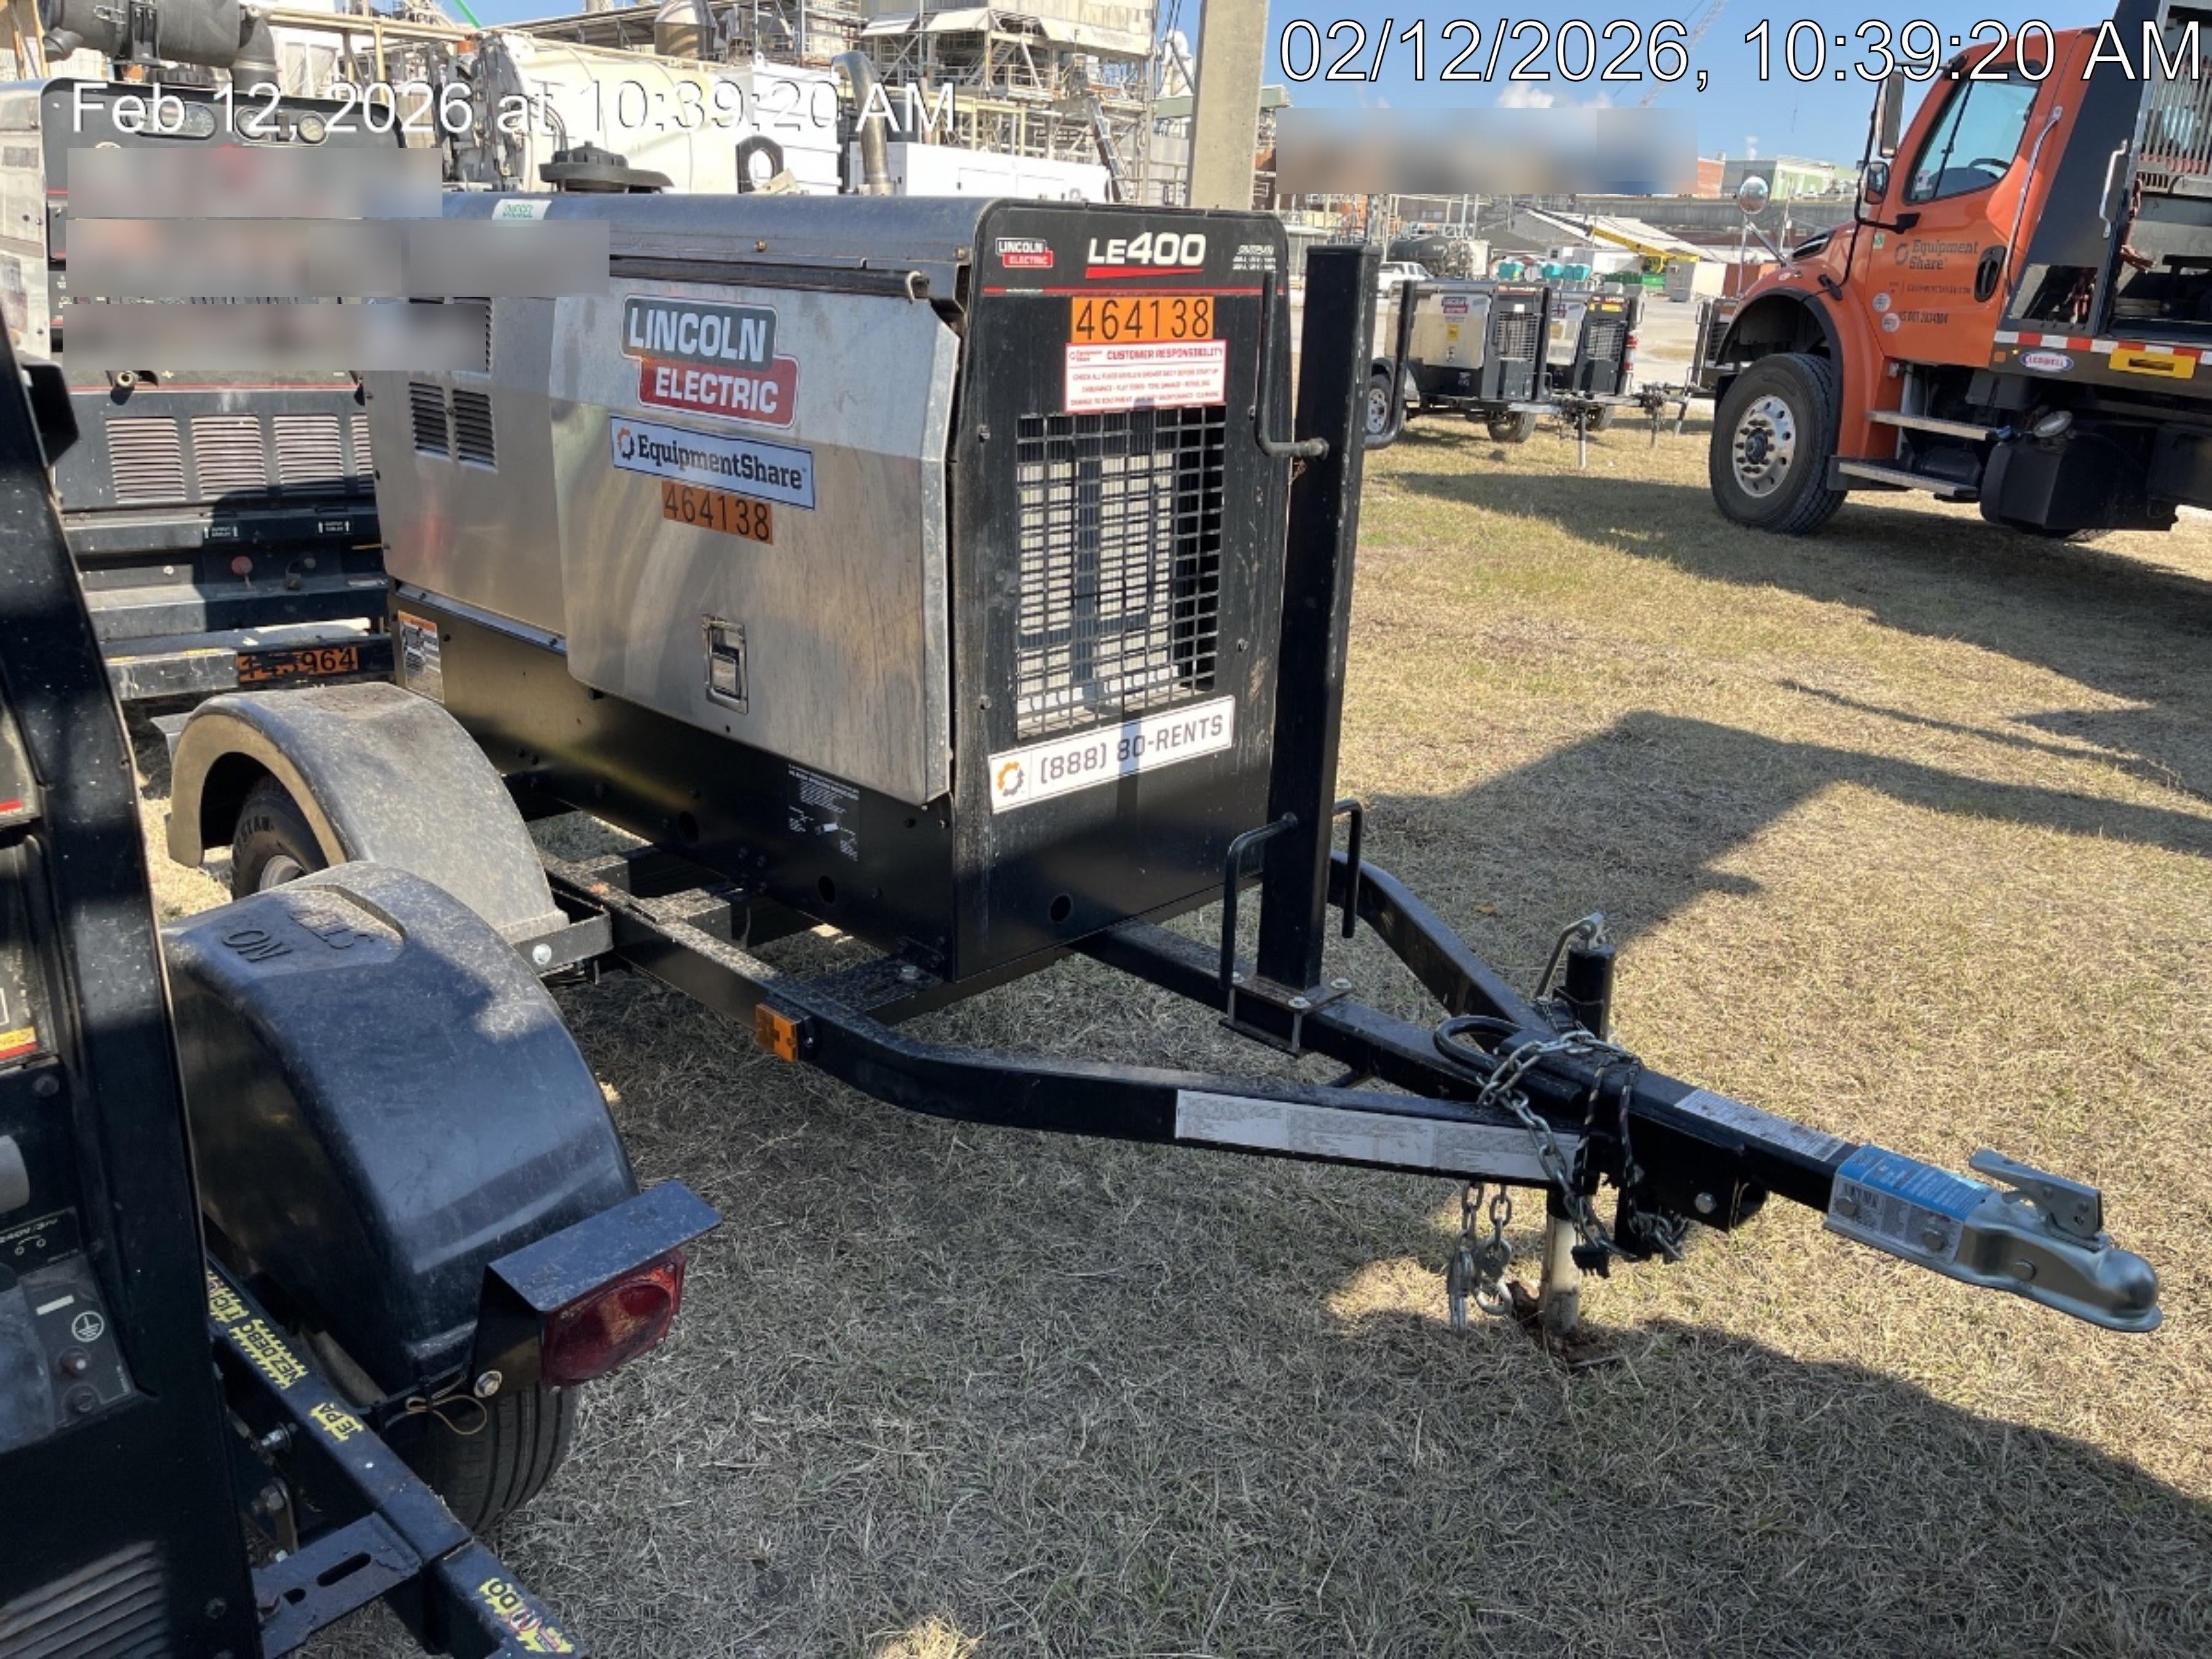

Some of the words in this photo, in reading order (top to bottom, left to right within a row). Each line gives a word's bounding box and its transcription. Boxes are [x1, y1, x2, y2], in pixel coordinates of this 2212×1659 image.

[998, 241, 1044, 253] LINCOLN
[1010, 256, 1048, 265] ELECTRIC
[1087, 231, 1207, 265] LE400
[1909, 256, 1944, 270] Share
[1912, 239, 1979, 256] Equipment
[629, 307, 767, 363] LINCOLN
[1076, 298, 1209, 340] 464138
[1107, 350, 1154, 360] CUSTOMER
[1156, 347, 1223, 358] RESPONSIBILITY
[655, 367, 779, 414] ELECTRIC
[637, 433, 802, 490] EquipmentShare
[664, 484, 771, 541] 464138
[1040, 742, 1107, 785] (888)
[1116, 714, 1223, 763] 80-RENTS
